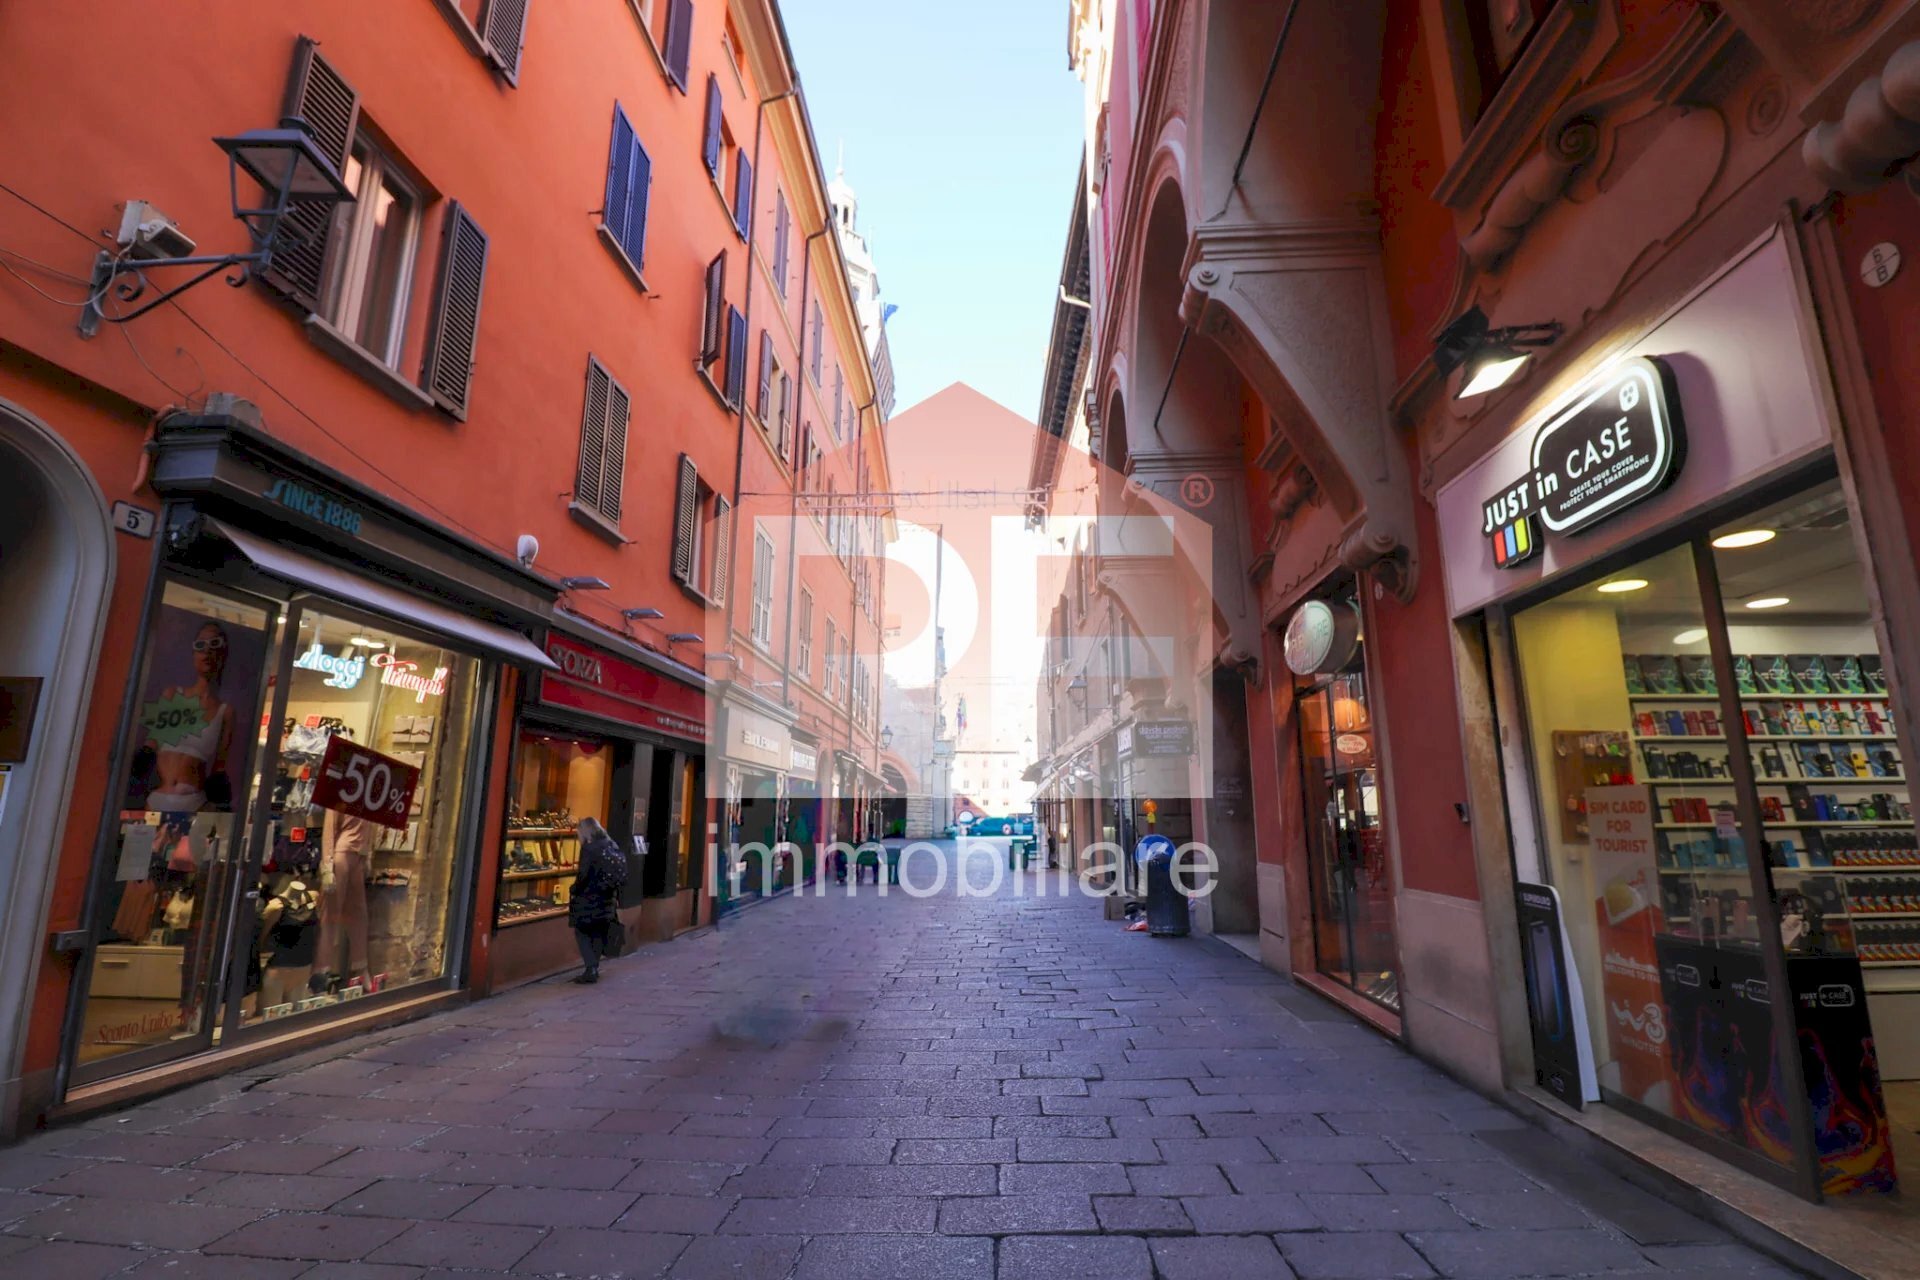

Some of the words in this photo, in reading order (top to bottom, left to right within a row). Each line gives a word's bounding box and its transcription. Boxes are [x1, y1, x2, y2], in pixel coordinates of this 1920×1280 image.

[1485, 482, 1529, 533] JUST
[1536, 472, 1559, 500] in
[1566, 416, 1632, 479] CASE
[1560, 493, 1585, 512] PROTECT
[1585, 482, 1603, 496] YOUR
[1604, 454, 1650, 486] SMARTPHONE
[1569, 479, 1591, 498] CREATE
[1592, 469, 1610, 483] YOUR
[1611, 454, 1634, 472] COVER
[125, 511, 140, 530] 5
[262, 479, 324, 520] SINCE
[324, 501, 362, 535] 1886
[370, 653, 448, 703] Triumph
[144, 708, 197, 729] -50%
[1590, 801, 1609, 815] SIM
[1613, 801, 1647, 814] CARD
[1606, 820, 1632, 833] FOR
[1595, 838, 1648, 853] TOURIST
